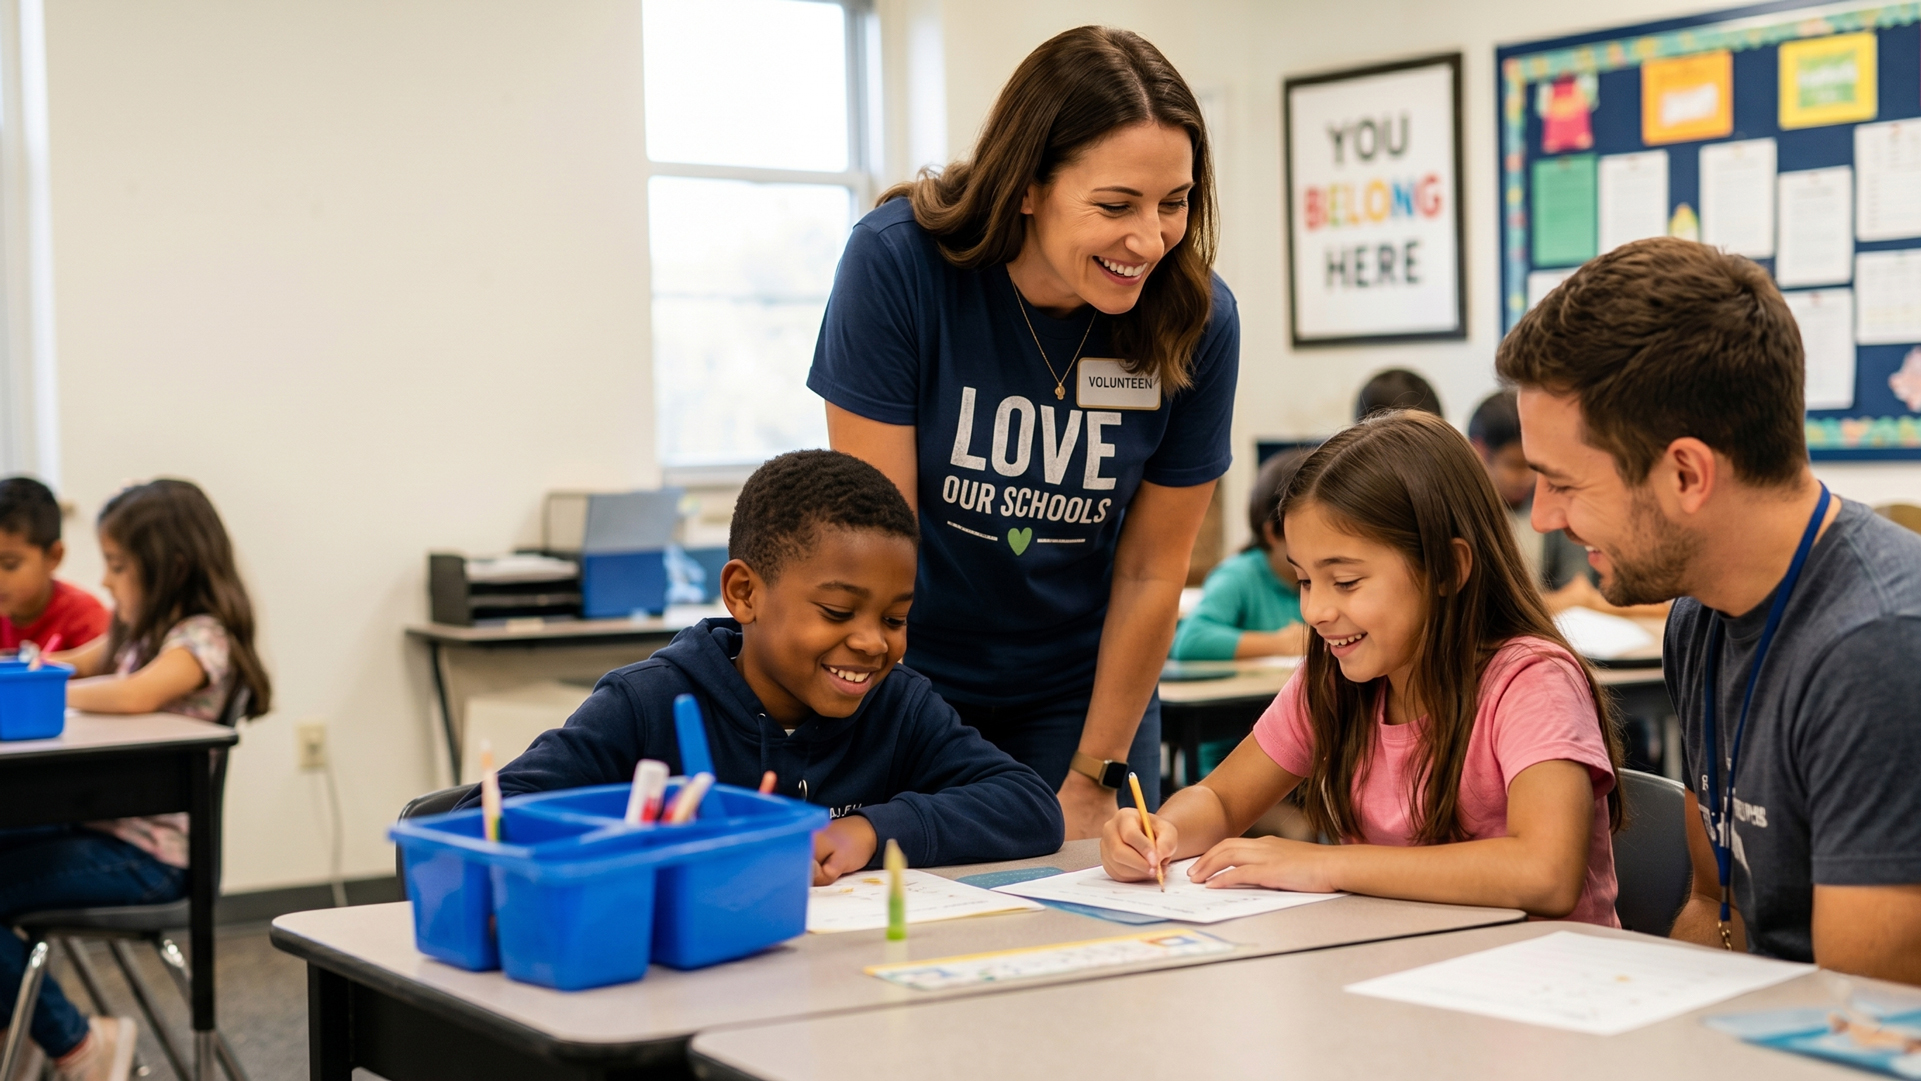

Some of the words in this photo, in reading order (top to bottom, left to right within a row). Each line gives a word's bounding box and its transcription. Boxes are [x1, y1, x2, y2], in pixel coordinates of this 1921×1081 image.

[1328, 114, 1409, 163] YOU
[1305, 174, 1440, 230] BELONG
[1326, 241, 1420, 287] HERE
[950, 386, 1122, 490] LOVE
[942, 475, 996, 514] OUR
[1000, 486, 1112, 524] SCHOOLS
